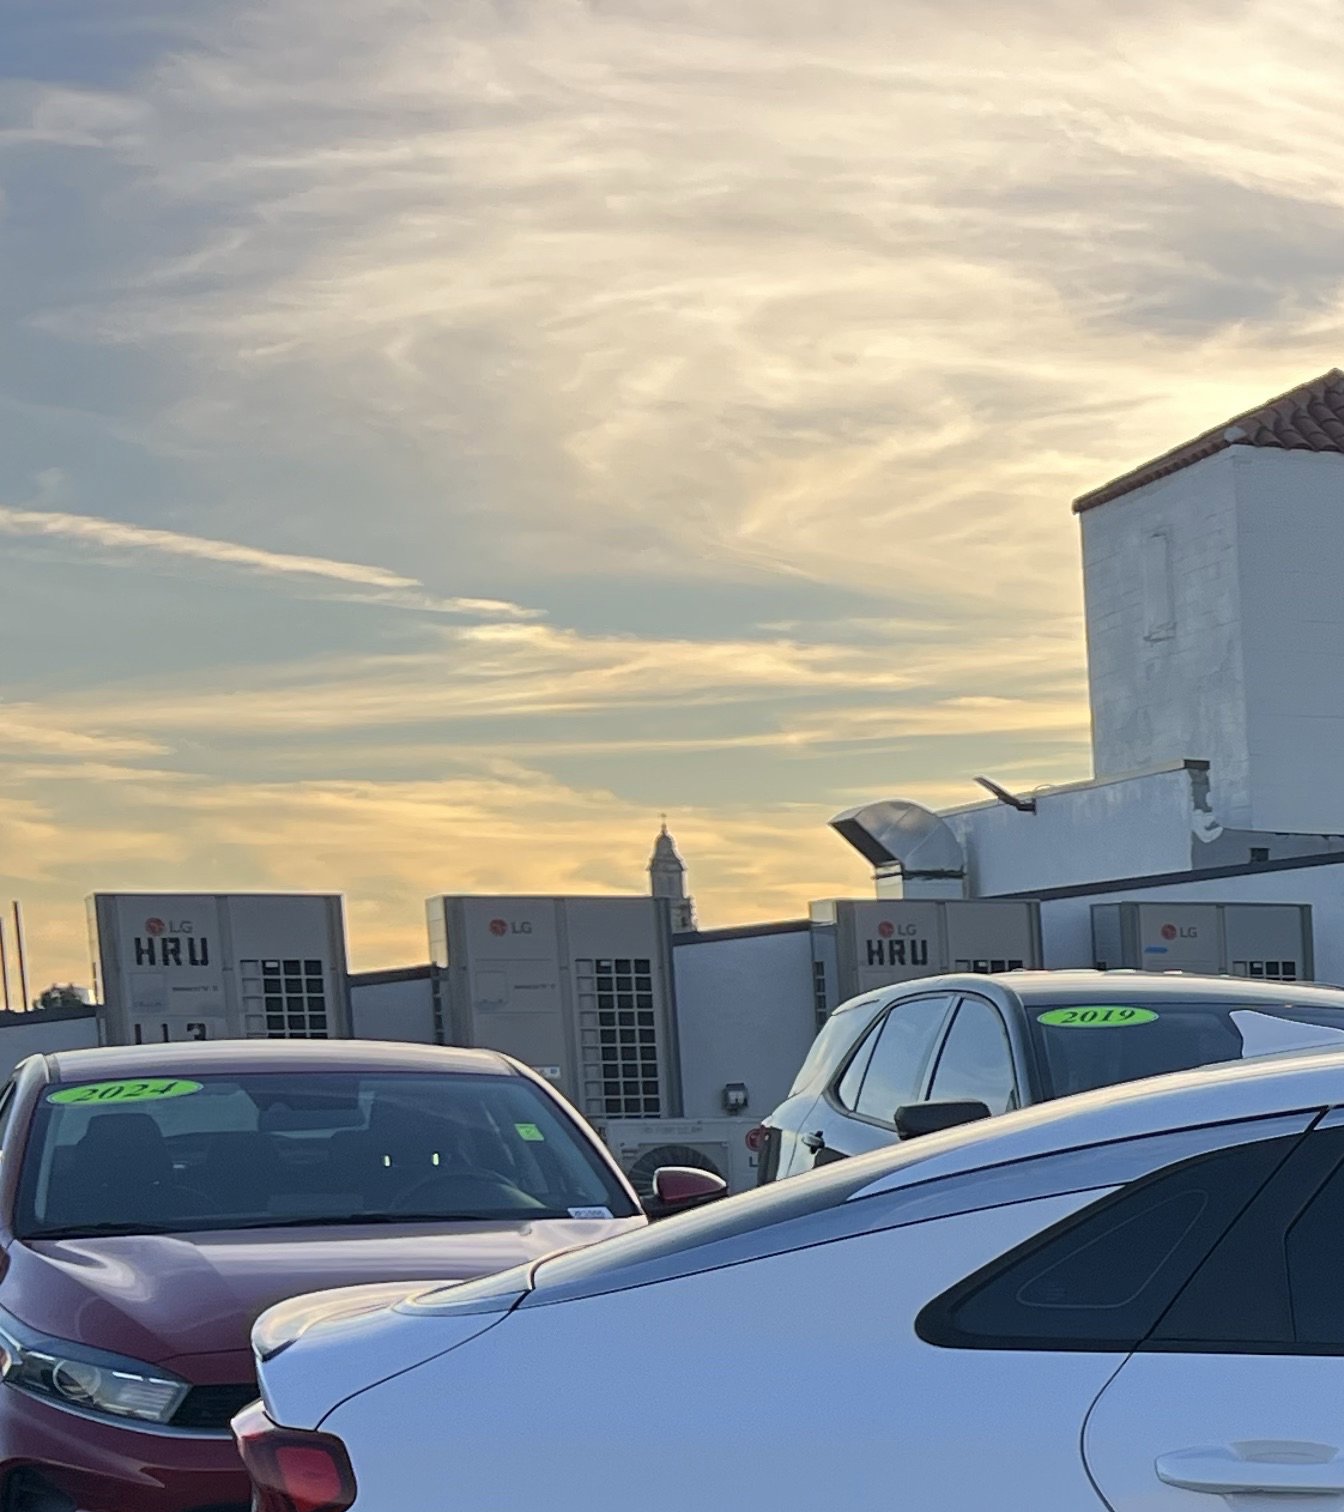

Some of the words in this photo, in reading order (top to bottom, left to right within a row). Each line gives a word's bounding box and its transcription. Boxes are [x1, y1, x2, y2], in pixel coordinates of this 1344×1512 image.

[168, 920, 193, 934] LG
[511, 921, 532, 934] LG
[897, 923, 917, 936] LG
[1180, 926, 1198, 938] LG
[134, 937, 209, 967] HRU
[866, 939, 928, 966] HRU
[1060, 1009, 1136, 1024] 2019
[72, 1081, 179, 1103] 2024
